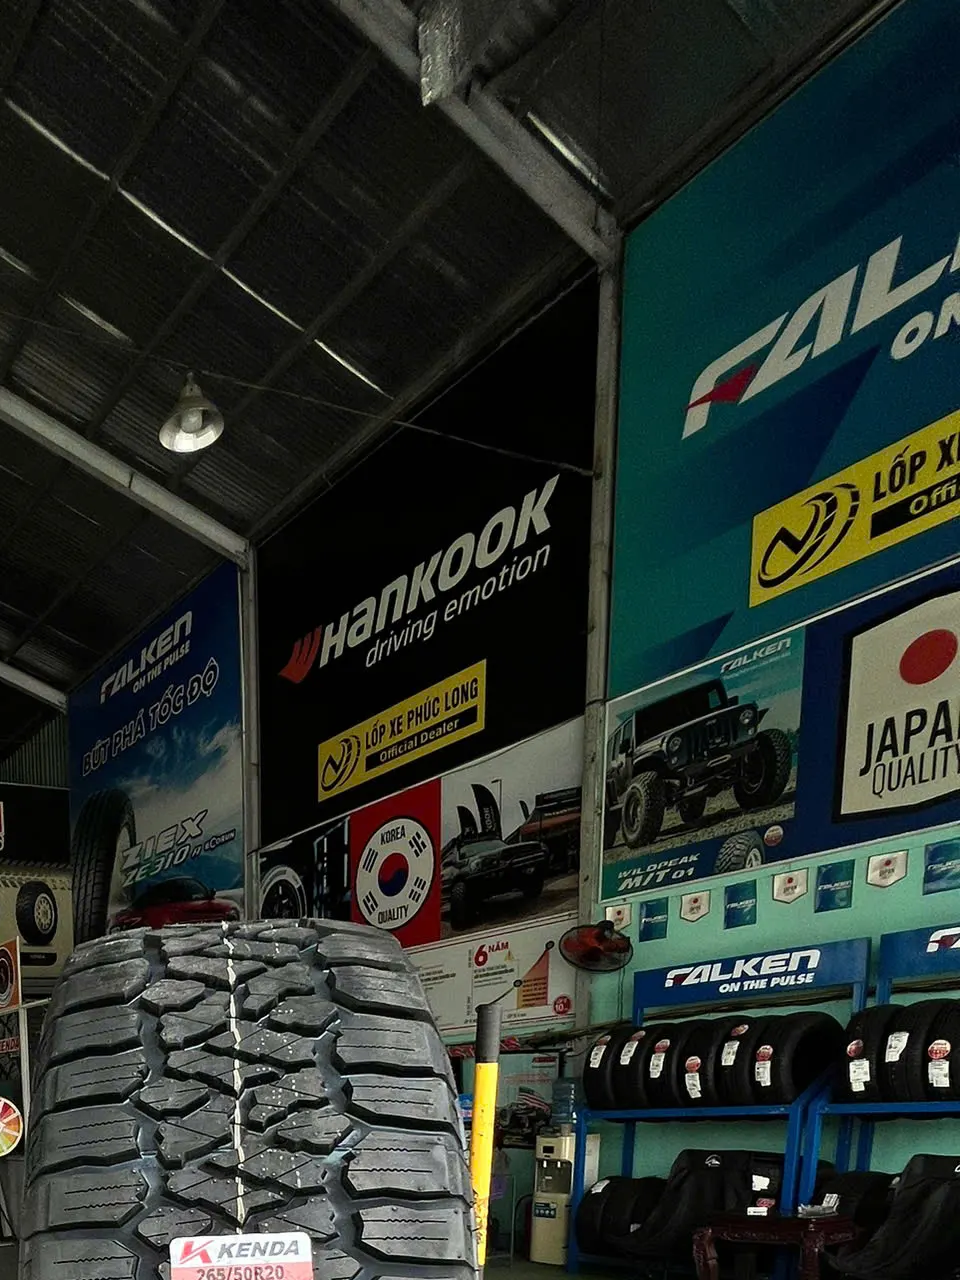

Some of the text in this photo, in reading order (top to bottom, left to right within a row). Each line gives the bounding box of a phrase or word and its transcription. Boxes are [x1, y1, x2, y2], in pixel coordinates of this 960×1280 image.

[682, 232, 960, 440] FAL
[873, 430, 960, 502] LỐP X
[365, 545, 550, 667] driving emotion
[100, 611, 192, 704] FALKEN
[133, 640, 190, 693] ON THE PULSE
[720, 637, 791, 673] FALKEN
[365, 678, 478, 749] LỐP XE PHÚC LONG
[379, 718, 460, 762] Official Dealer
[859, 700, 960, 776] JAPA
[121, 809, 208, 871] ZIEX
[380, 825, 406, 845] KOREA
[617, 868, 670, 892] M/T
[618, 853, 700, 879] WILDPEAK
[378, 904, 410, 924] QUALITY
[474, 944, 488, 967] 6
[489, 941, 509, 953] NĂM
[665, 949, 821, 988] FALKEN
[719, 973, 815, 993] ON THE PULSE
[217, 1240, 299, 1259] KENDA
